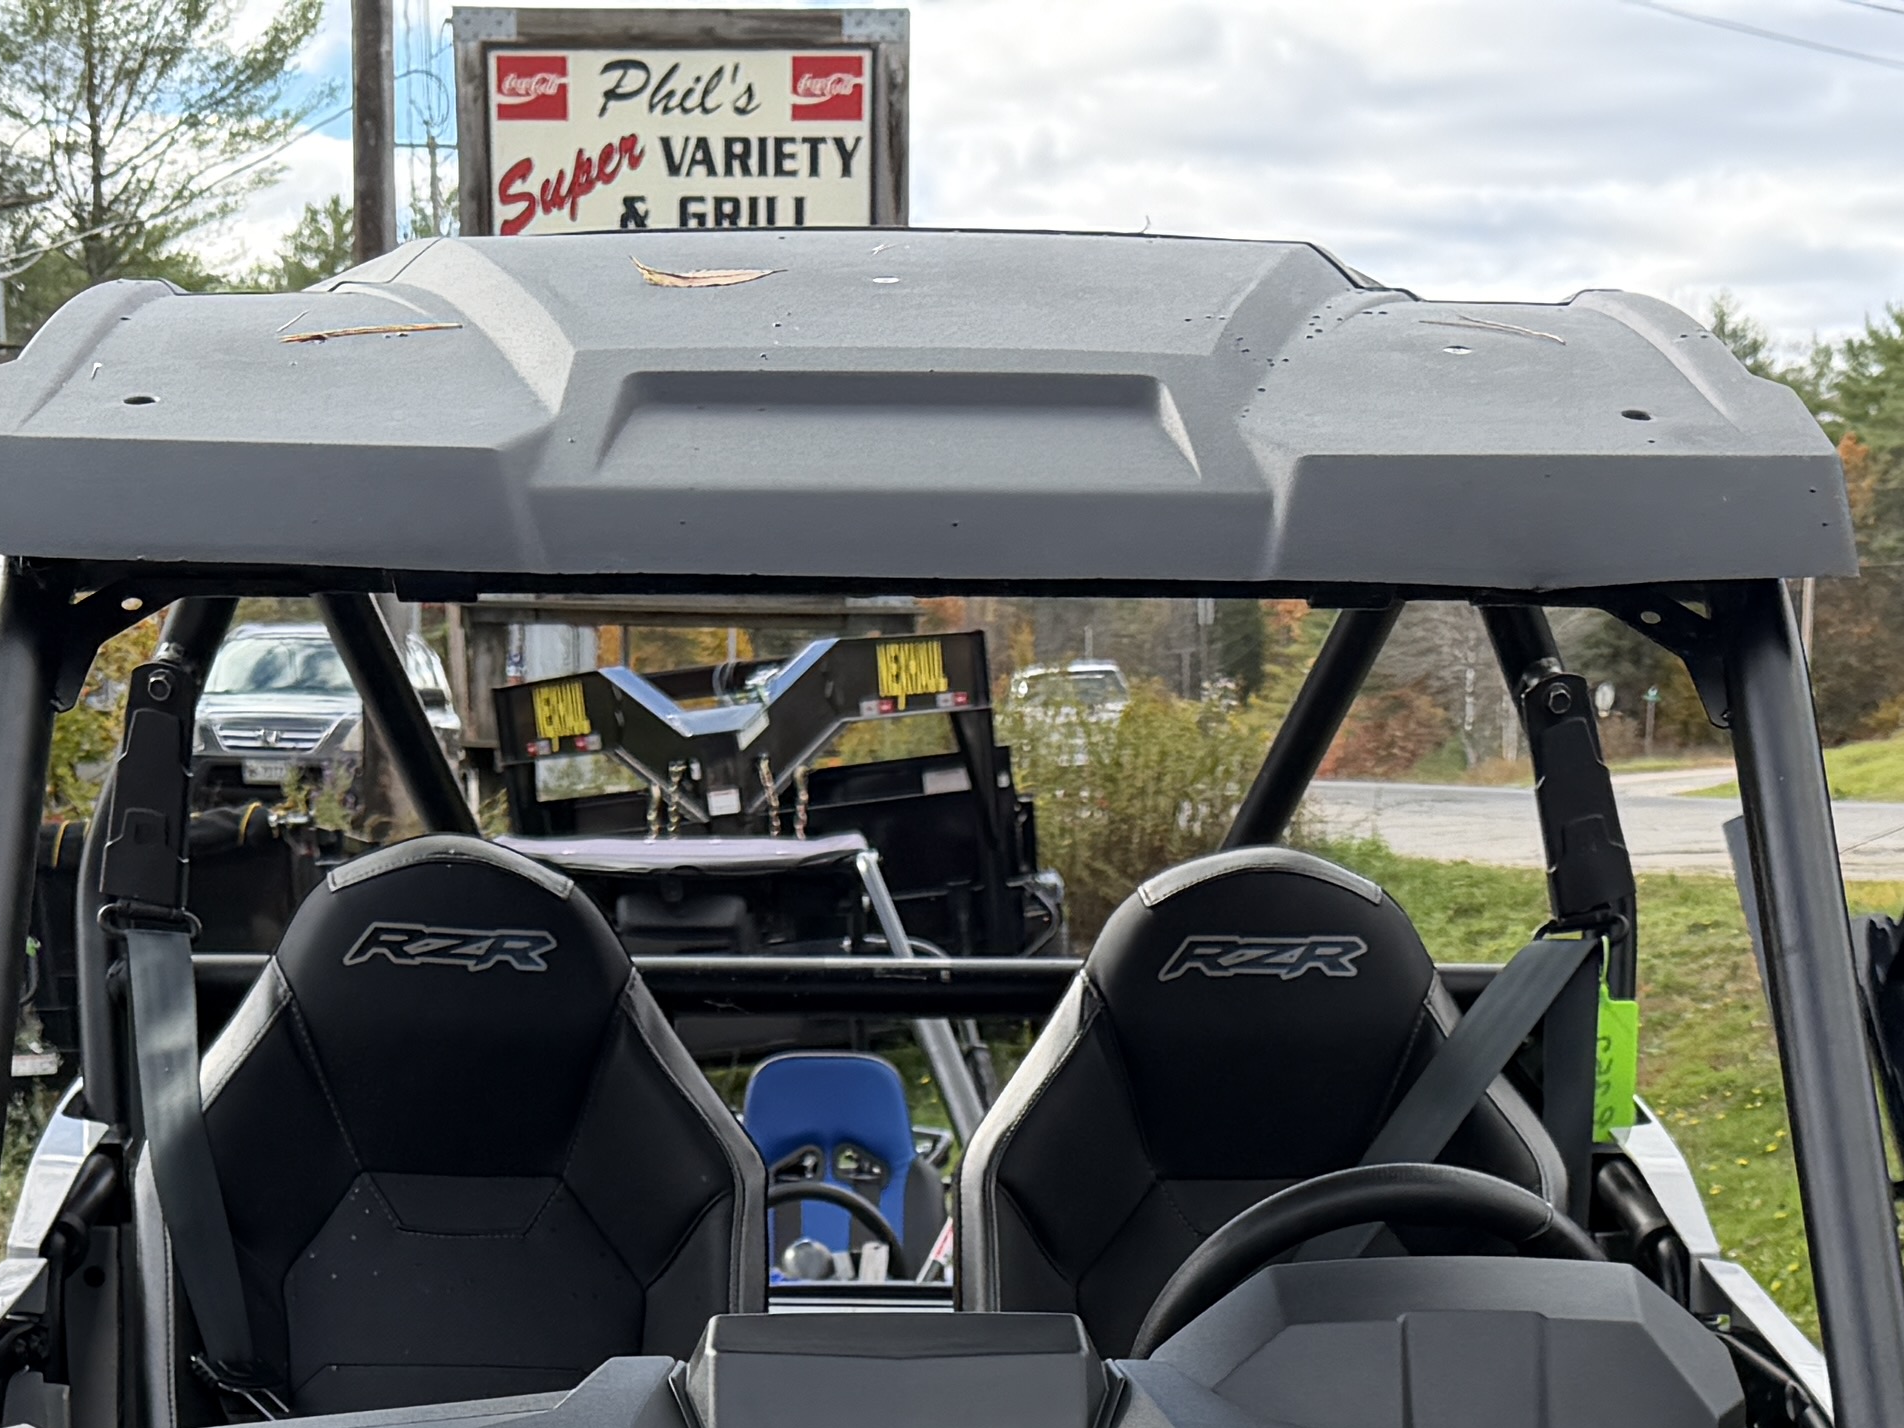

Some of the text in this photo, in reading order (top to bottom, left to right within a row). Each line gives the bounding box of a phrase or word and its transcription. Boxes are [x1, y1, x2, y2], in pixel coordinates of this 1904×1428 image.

[598, 59, 761, 118] Phil's
[498, 133, 863, 236] Super VARIETY
[620, 195, 648, 228] &
[342, 921, 557, 972] RZR
[1157, 935, 1368, 981] RZR
